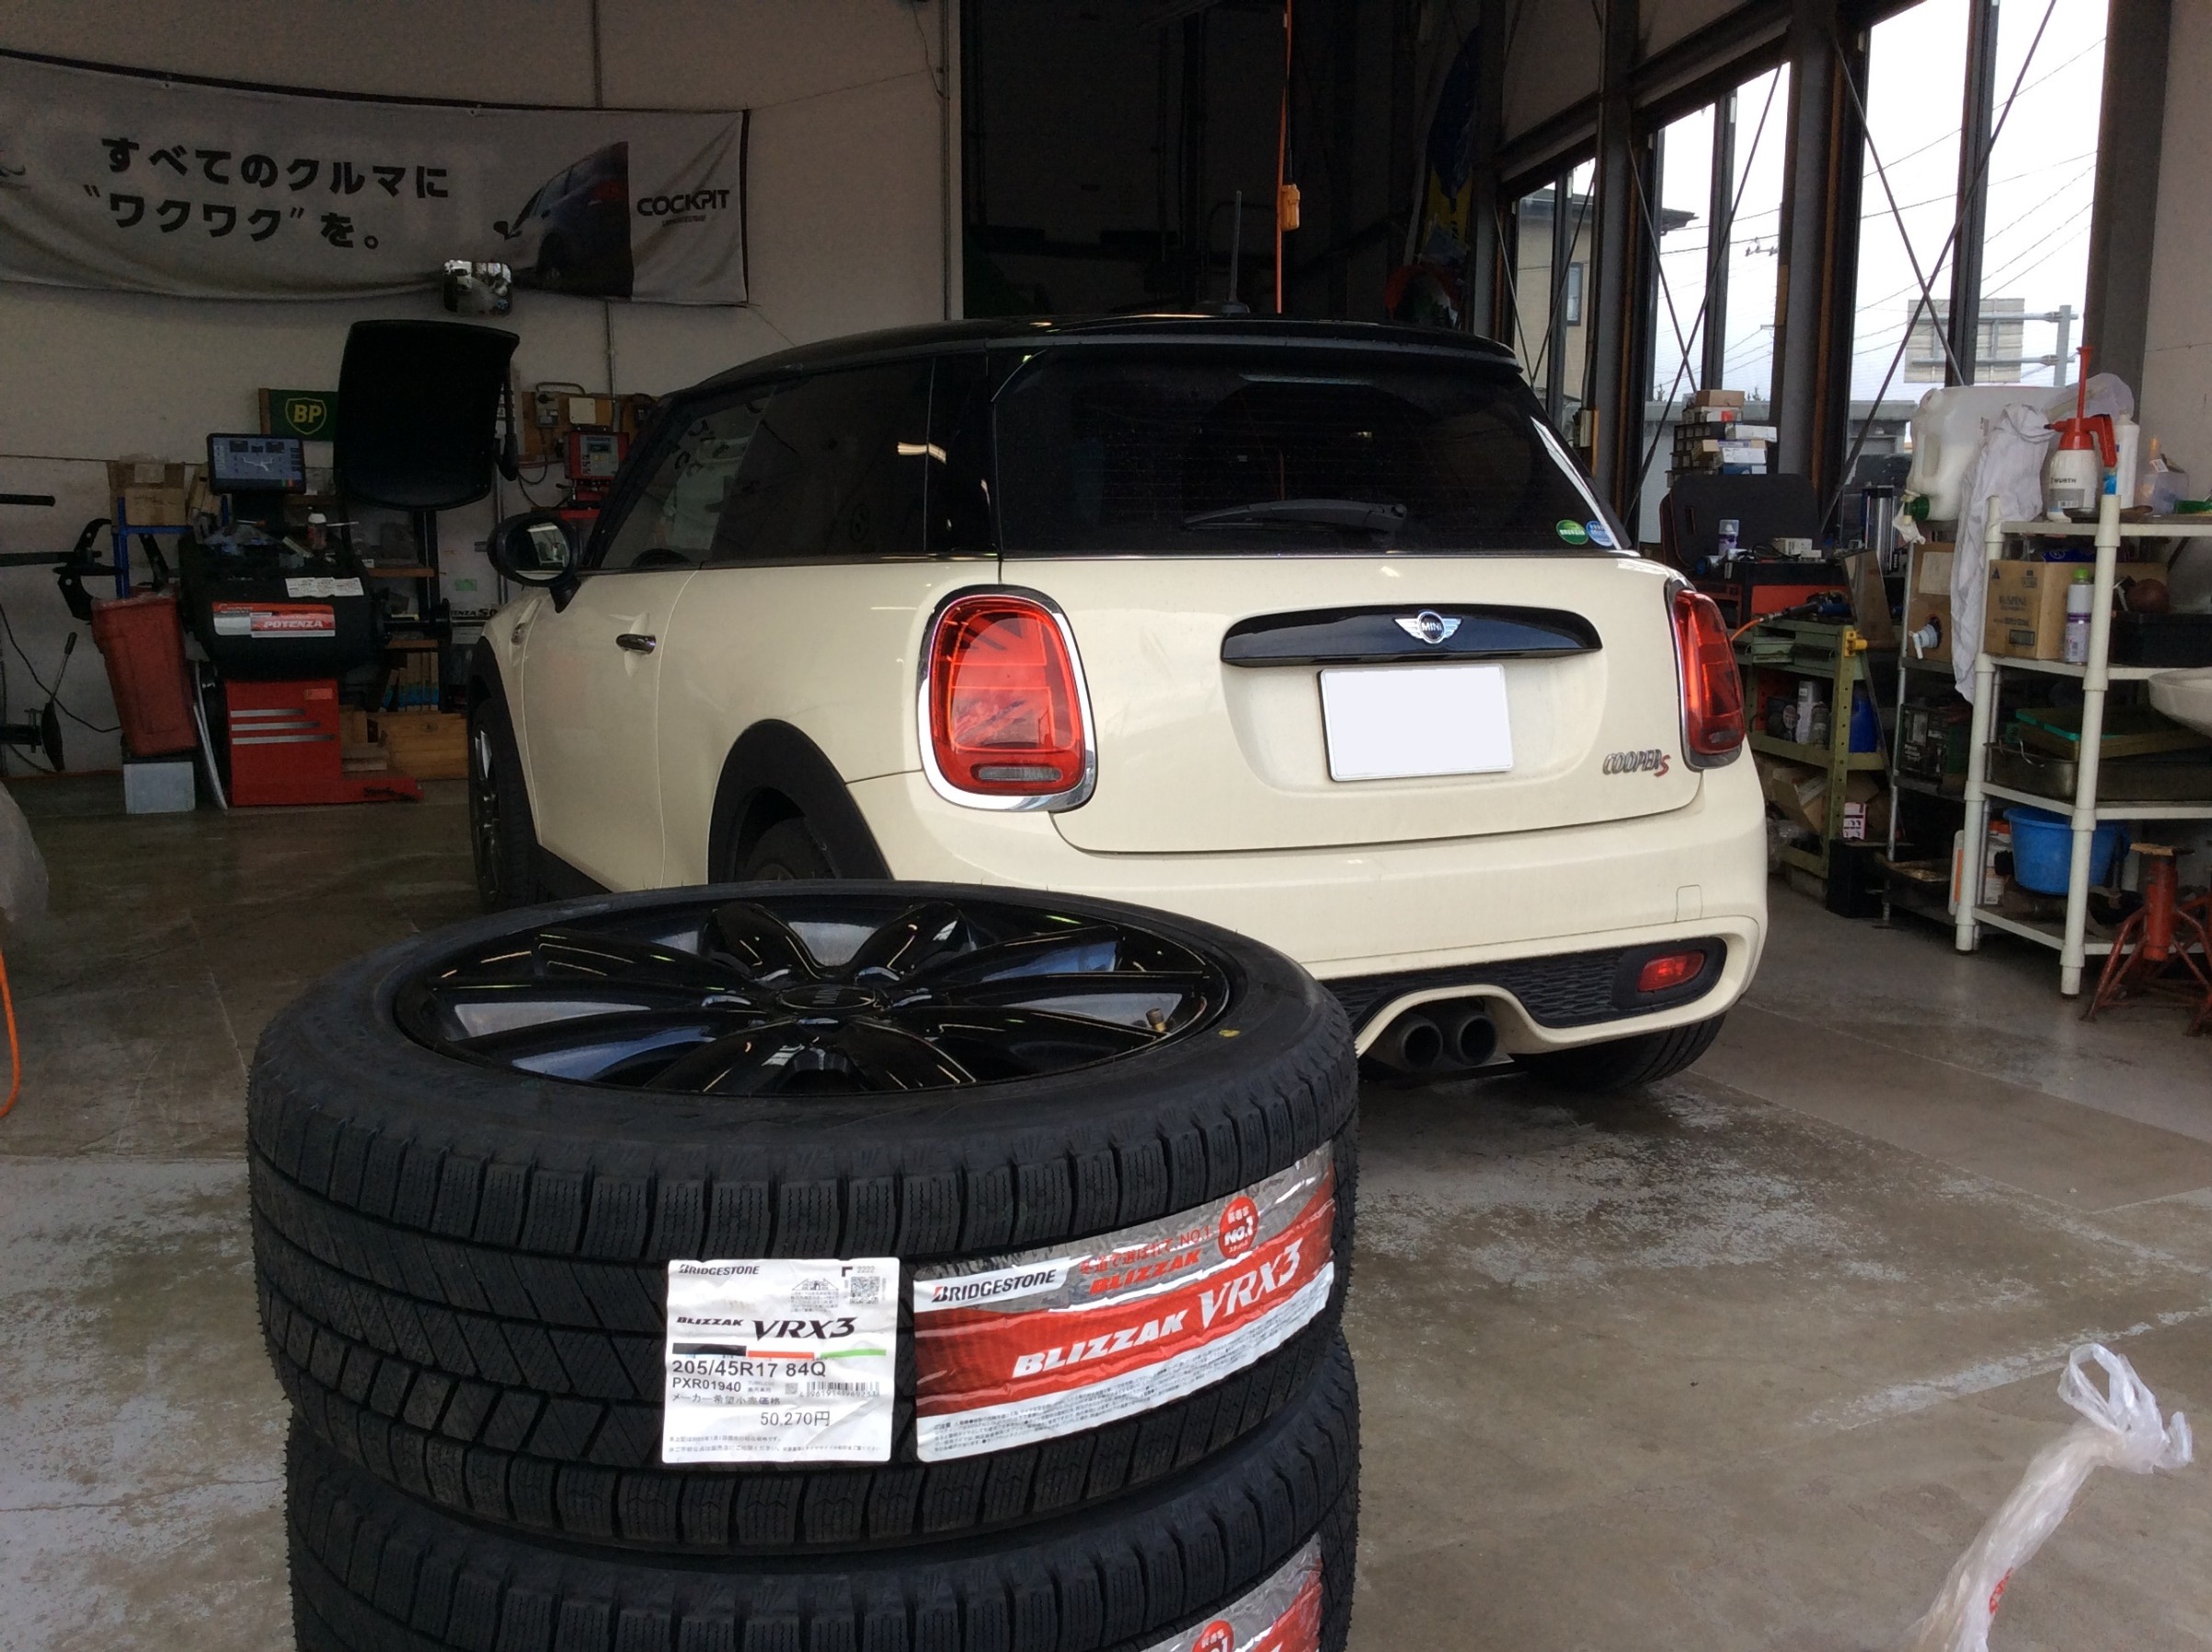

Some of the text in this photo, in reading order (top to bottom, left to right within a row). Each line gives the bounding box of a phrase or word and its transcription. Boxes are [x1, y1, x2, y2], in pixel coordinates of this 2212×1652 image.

[101, 137, 449, 199] すべてのクルマに
[636, 189, 730, 216] COCKPIT
[293, 404, 323, 423] BP
[263, 619, 324, 628] POTENZA
[1421, 622, 1442, 632] MINI
[1602, 749, 1671, 777] COOPER S
[678, 1264, 761, 1276] BRIDGESTONE
[1089, 1246, 1203, 1295] BLIZZAK
[931, 1269, 1056, 1303] BRIDGESTONE
[1012, 1309, 1189, 1378] BLIZZAK
[1197, 1237, 1303, 1329] VRX3
[676, 1316, 858, 1341] BLIZZAK VRX3
[671, 1359, 827, 1378] 205/45R17 84Q
[671, 1377, 741, 1393] PXR01940
[671, 1393, 781, 1406] メーカー希望小売価格
[760, 1410, 831, 1428] 50,270円
